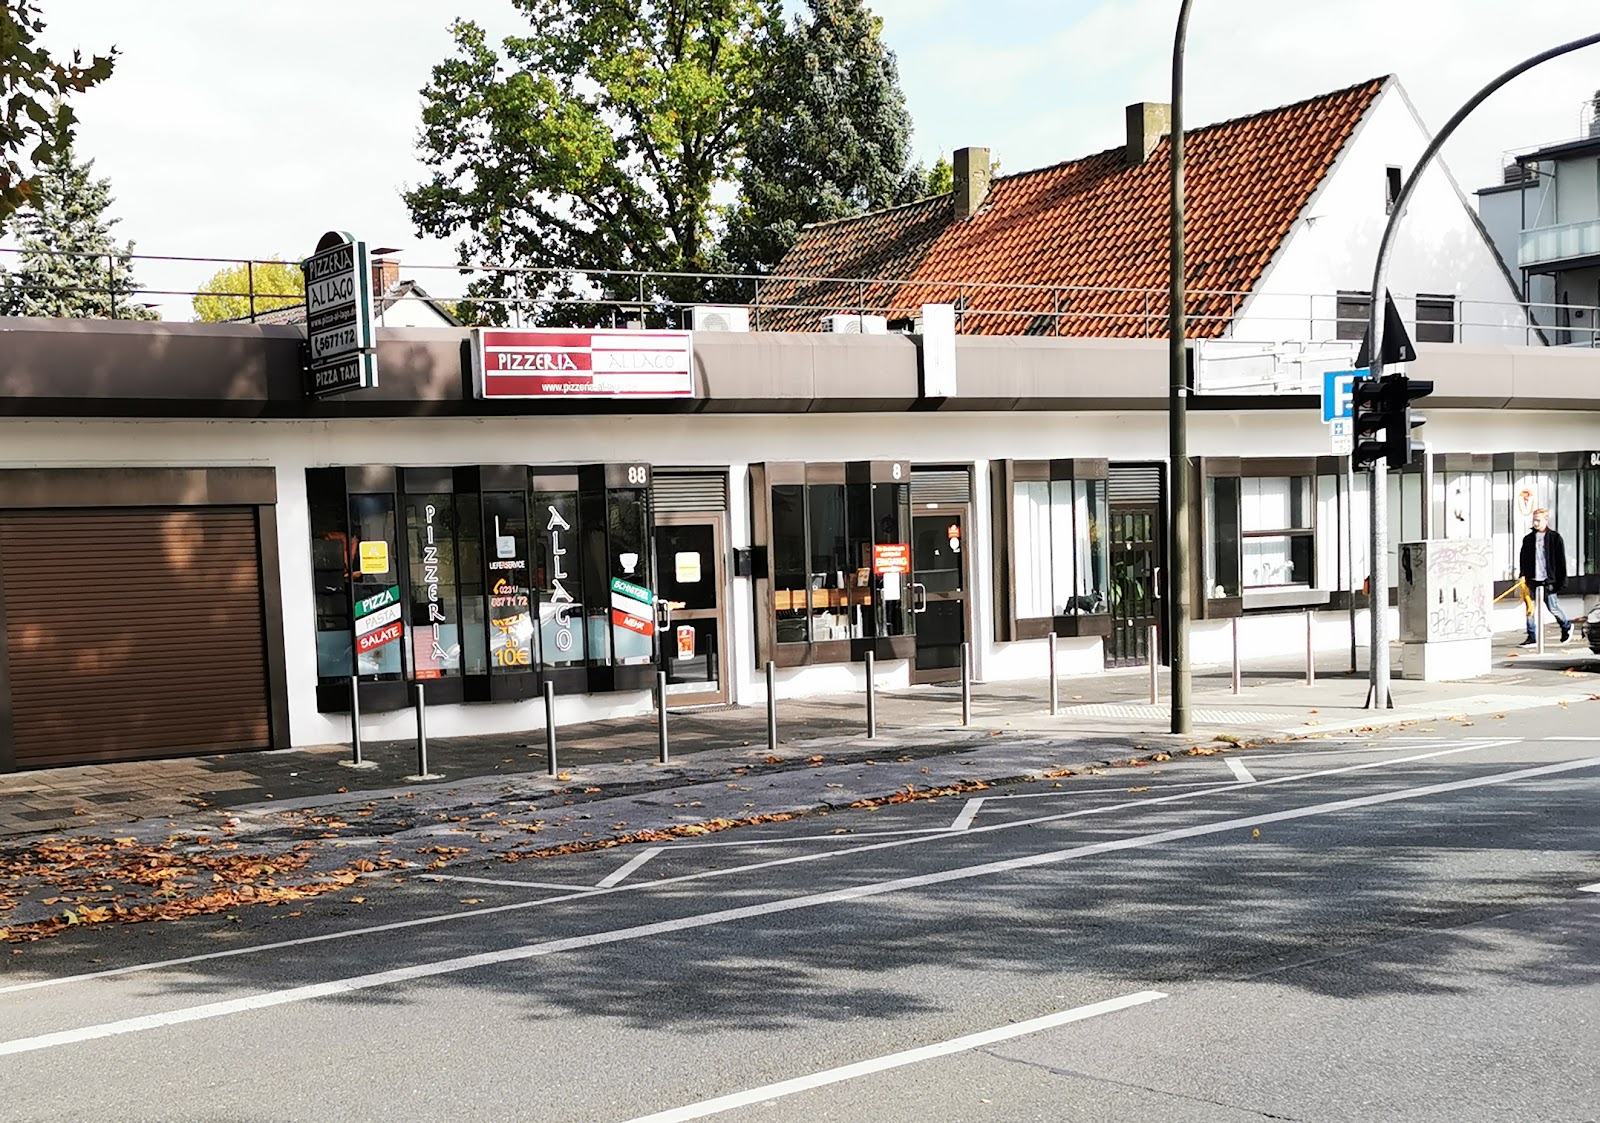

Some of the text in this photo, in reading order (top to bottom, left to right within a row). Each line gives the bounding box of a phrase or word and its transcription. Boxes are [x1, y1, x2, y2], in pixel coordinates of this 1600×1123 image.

[309, 250, 353, 281] PIZZERIA
[326, 277, 354, 302] LAGO
[320, 329, 355, 351] 5677172
[497, 353, 578, 371] PIZZERIA
[315, 363, 358, 387] PIZZA TAXI
[628, 466, 647, 484] 88
[424, 505, 449, 660] PIZZERIA
[362, 590, 394, 613] PIZZA
[365, 609, 397, 629] PASTA
[492, 613, 526, 627] PIZZA
[623, 616, 646, 631] MEHR
[360, 626, 400, 649] SALATE
[505, 638, 519, 648] ab
[495, 647, 531, 666] 10€
